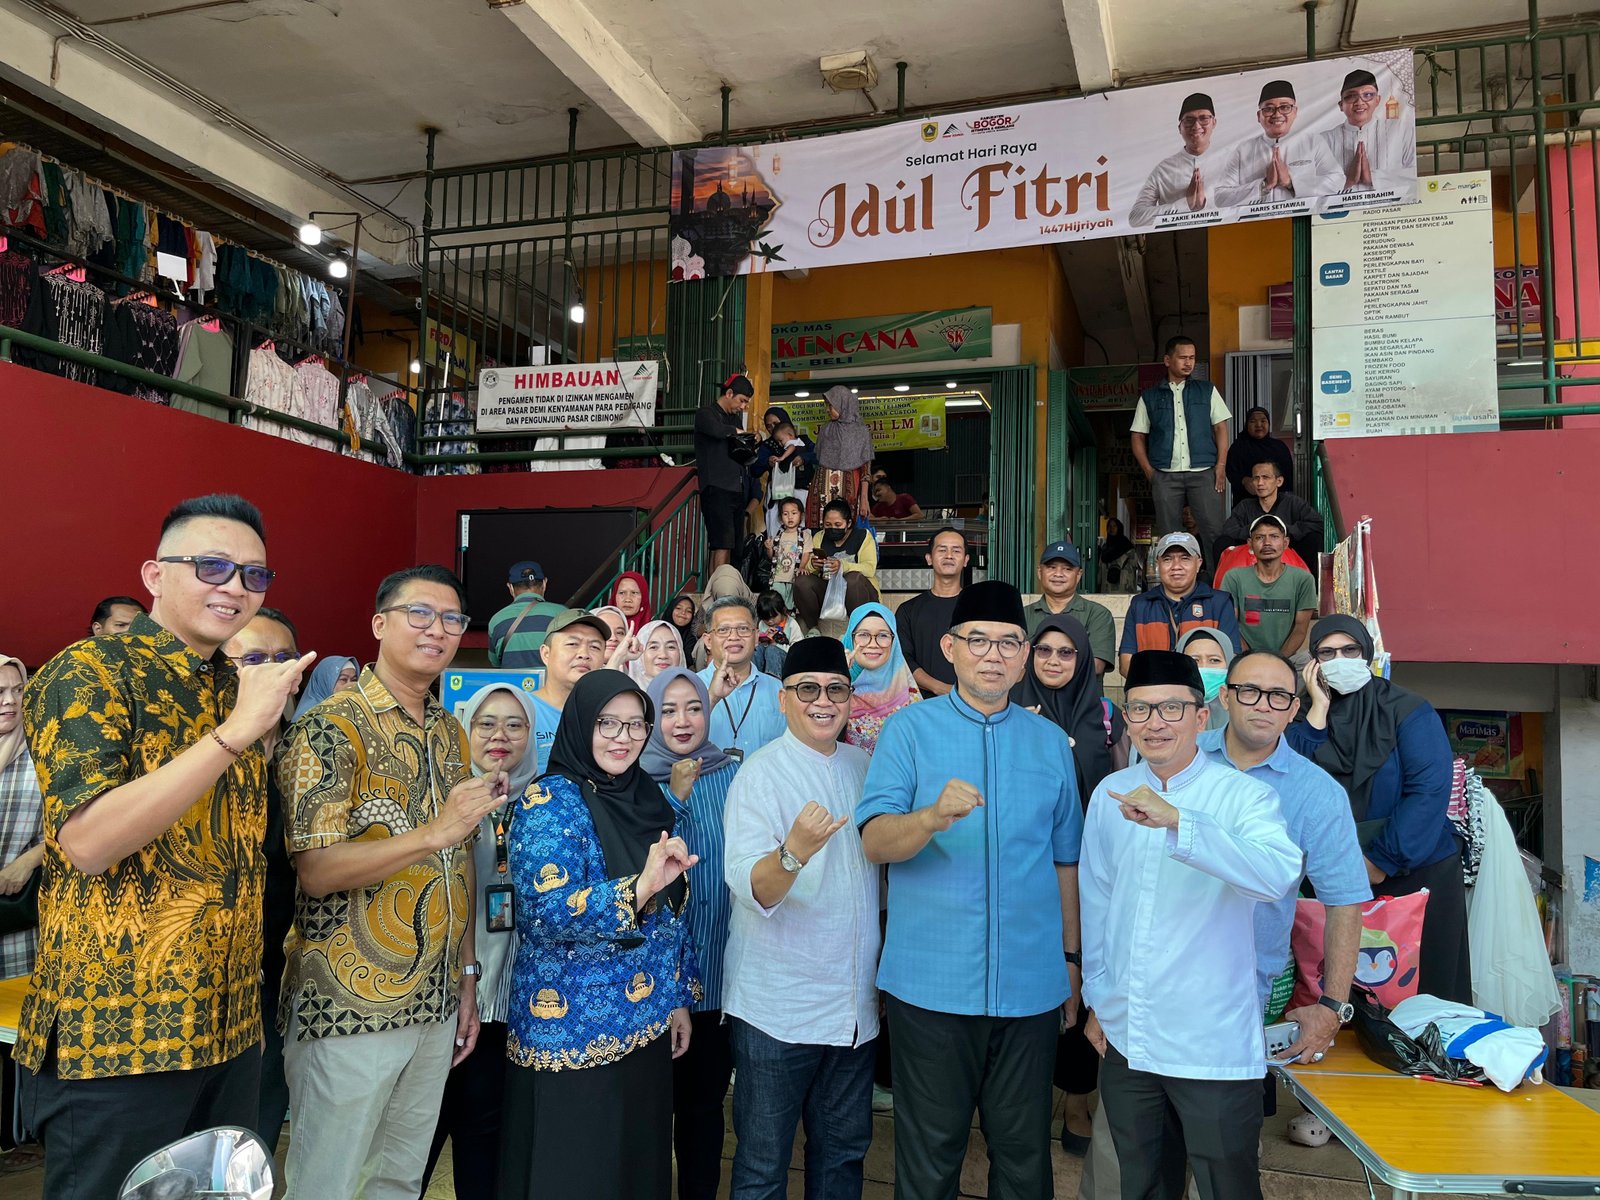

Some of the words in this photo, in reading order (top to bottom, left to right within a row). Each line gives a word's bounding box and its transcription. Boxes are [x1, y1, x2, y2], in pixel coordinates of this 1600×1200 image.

[974, 117, 1012, 129] BOGOR
[905, 150, 964, 168] Selamat
[968, 144, 997, 160] Hari
[1000, 141, 1038, 156] Raya
[960, 154, 1110, 232] Fitri
[1343, 194, 1363, 202] HARIS
[1364, 191, 1394, 199] IBRAHIM
[1272, 201, 1306, 210] SETIAWAN
[1191, 211, 1219, 219] HANIFAN
[1039, 218, 1114, 236] 1447Hijriyah
[1364, 260, 1410, 268] PERLENGKAPAN
[771, 326, 799, 334] OKO
[804, 323, 832, 332] MAS
[777, 328, 918, 359] KENCANA
[809, 356, 853, 366] BELI
[514, 370, 619, 390] HIMBAUAN
[498, 395, 534, 405] PENGAMEN
[536, 395, 555, 403] TIDAK
[557, 394, 564, 402] DI
[565, 393, 593, 402] IZINKAN
[594, 392, 634, 401] MENGAMEN
[489, 407, 506, 415] AREA
[507, 406, 528, 414] PASAR
[530, 406, 546, 414] DEMI
[548, 404, 594, 413] KENYAMANAN
[596, 403, 613, 412] PARA
[615, 402, 652, 411] PEDAGANG
[506, 417, 519, 425] DAN
[520, 415, 566, 424] PENGUNJUNG
[567, 415, 589, 423] PASAR
[590, 414, 624, 422] CIBINONG
[865, 420, 883, 431] eli
[892, 418, 914, 430] LM
